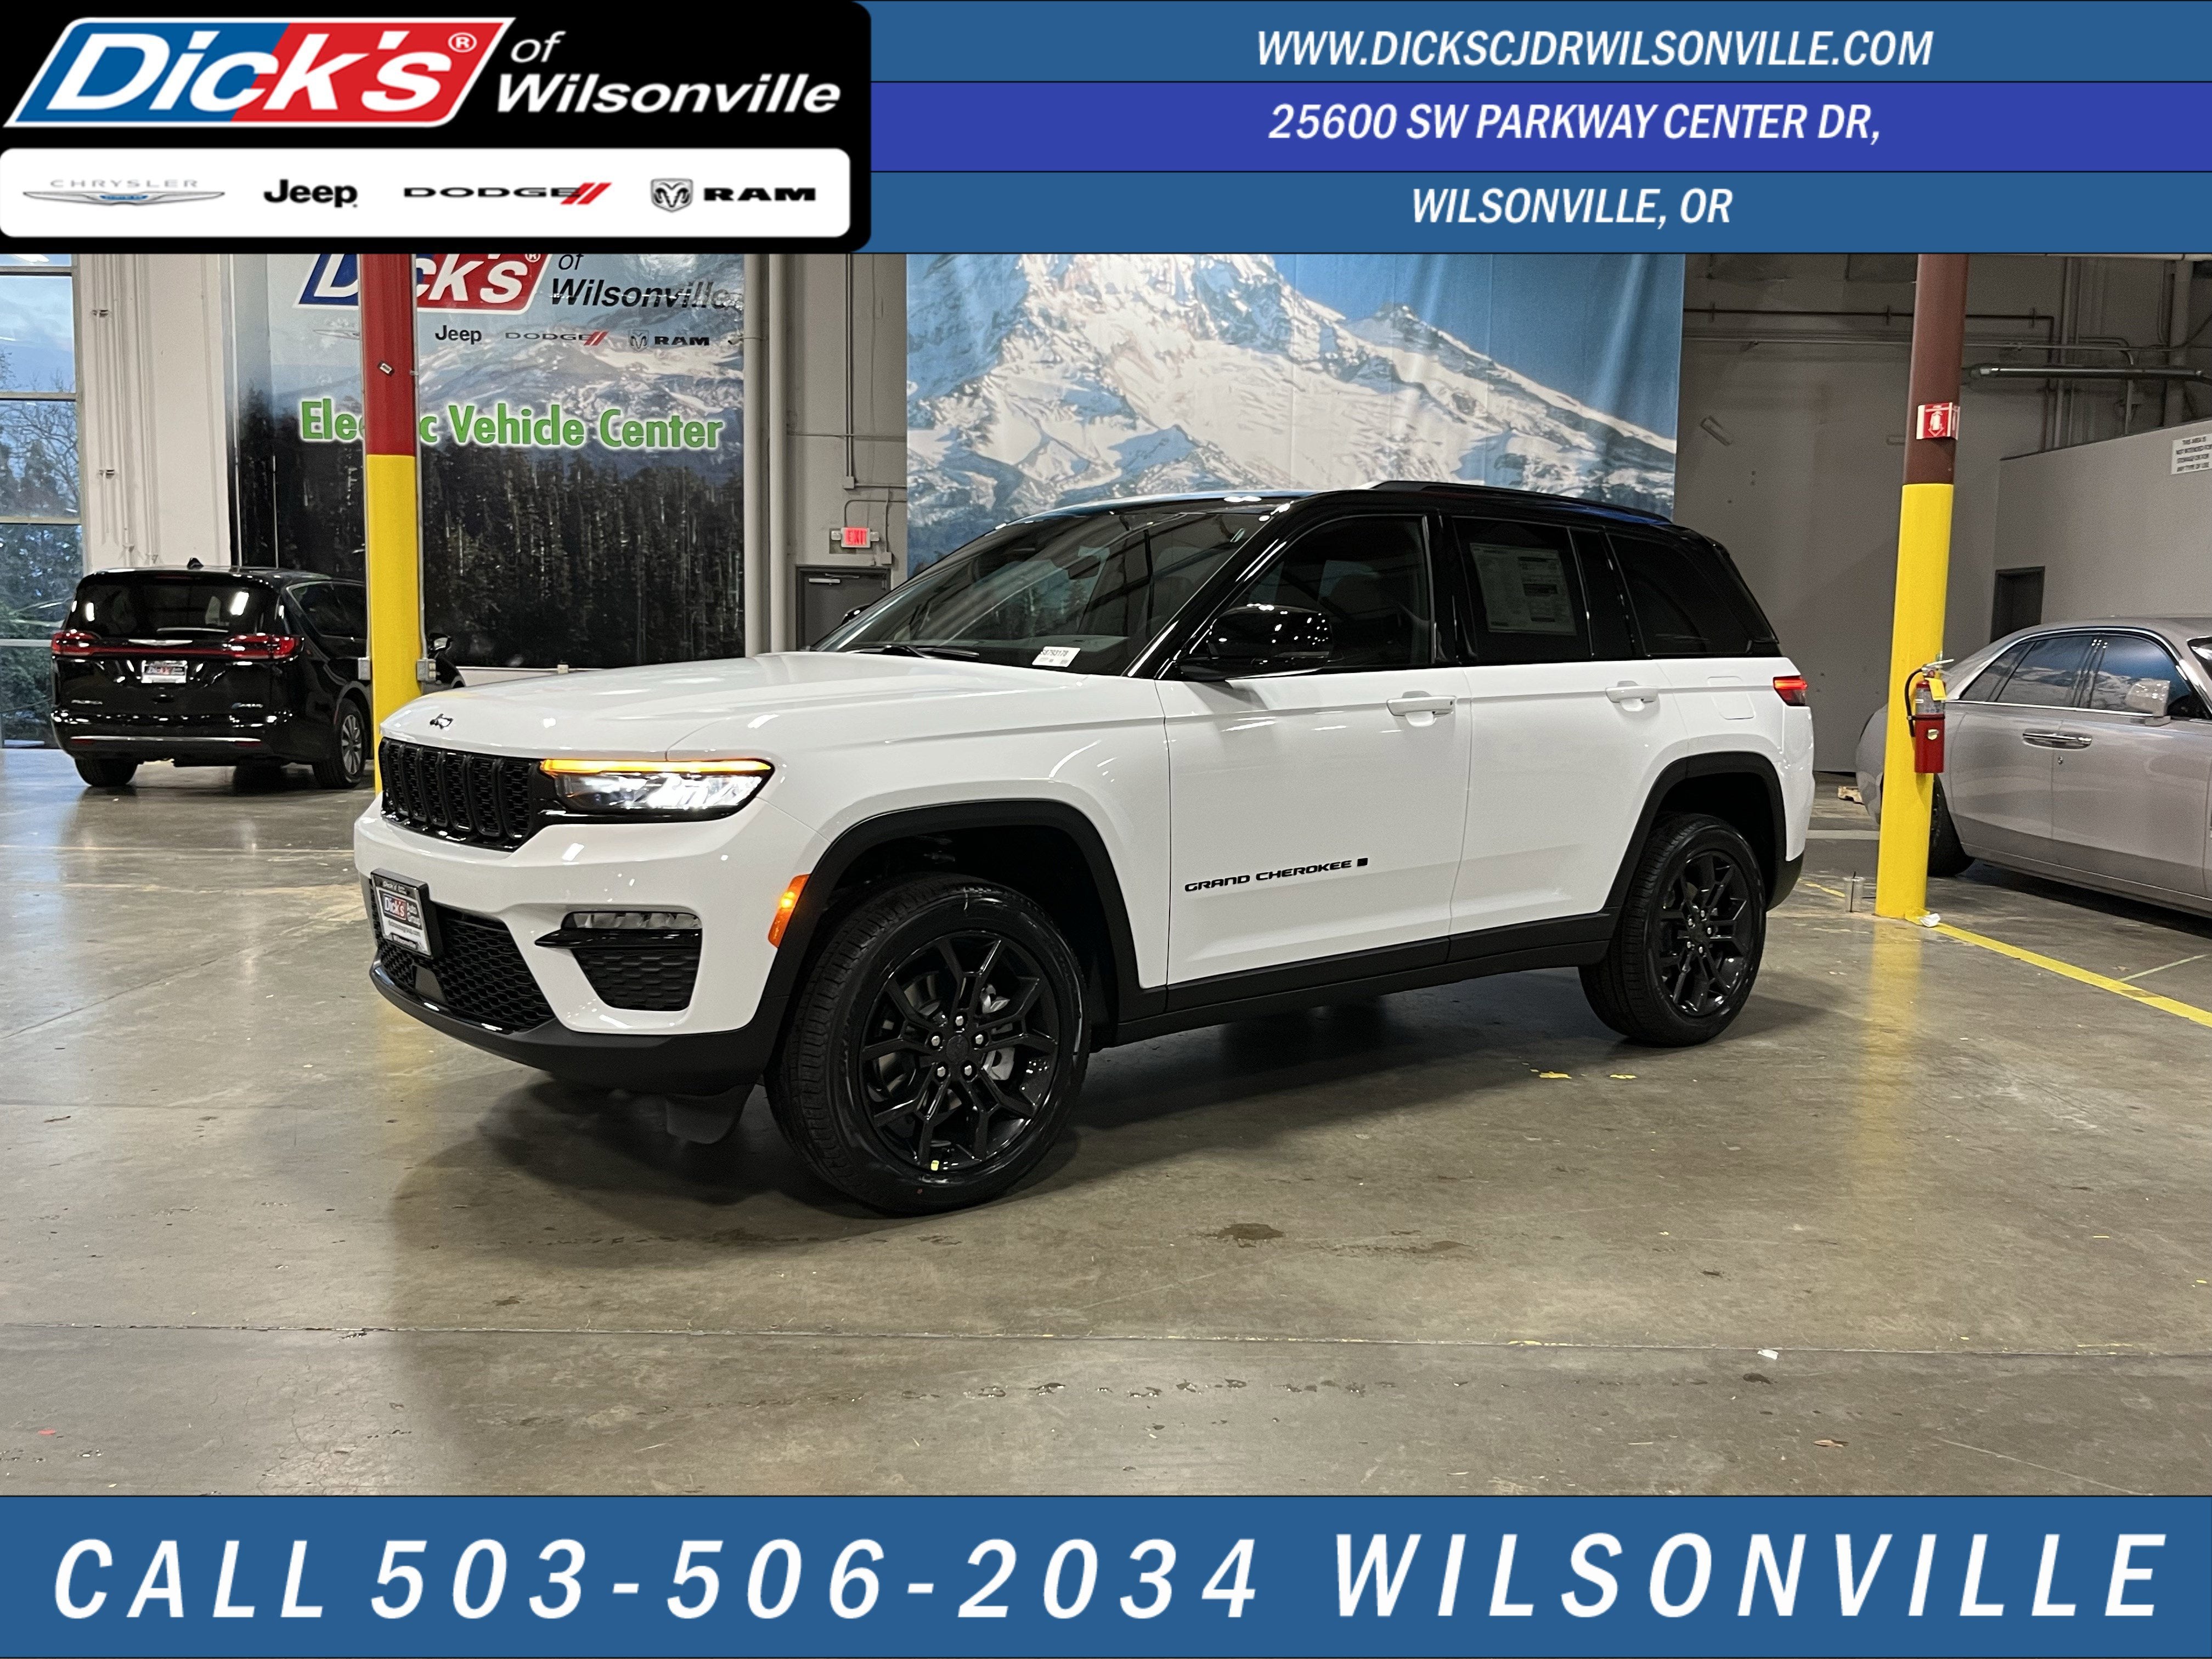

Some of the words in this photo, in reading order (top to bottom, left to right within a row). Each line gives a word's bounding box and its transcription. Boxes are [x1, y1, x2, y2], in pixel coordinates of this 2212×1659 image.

[314, 254, 528, 303] Dcks
[435, 325, 482, 345] Jeep
[505, 332, 589, 341] DODGE
[654, 336, 710, 346] RAM
[302, 398, 437, 443] Elec
[449, 403, 584, 445] Vehicle
[600, 409, 722, 447] Center
[847, 530, 867, 545] EXIT
[1184, 874, 1251, 892] GRAND
[1255, 860, 1352, 881] CHEROKEE
